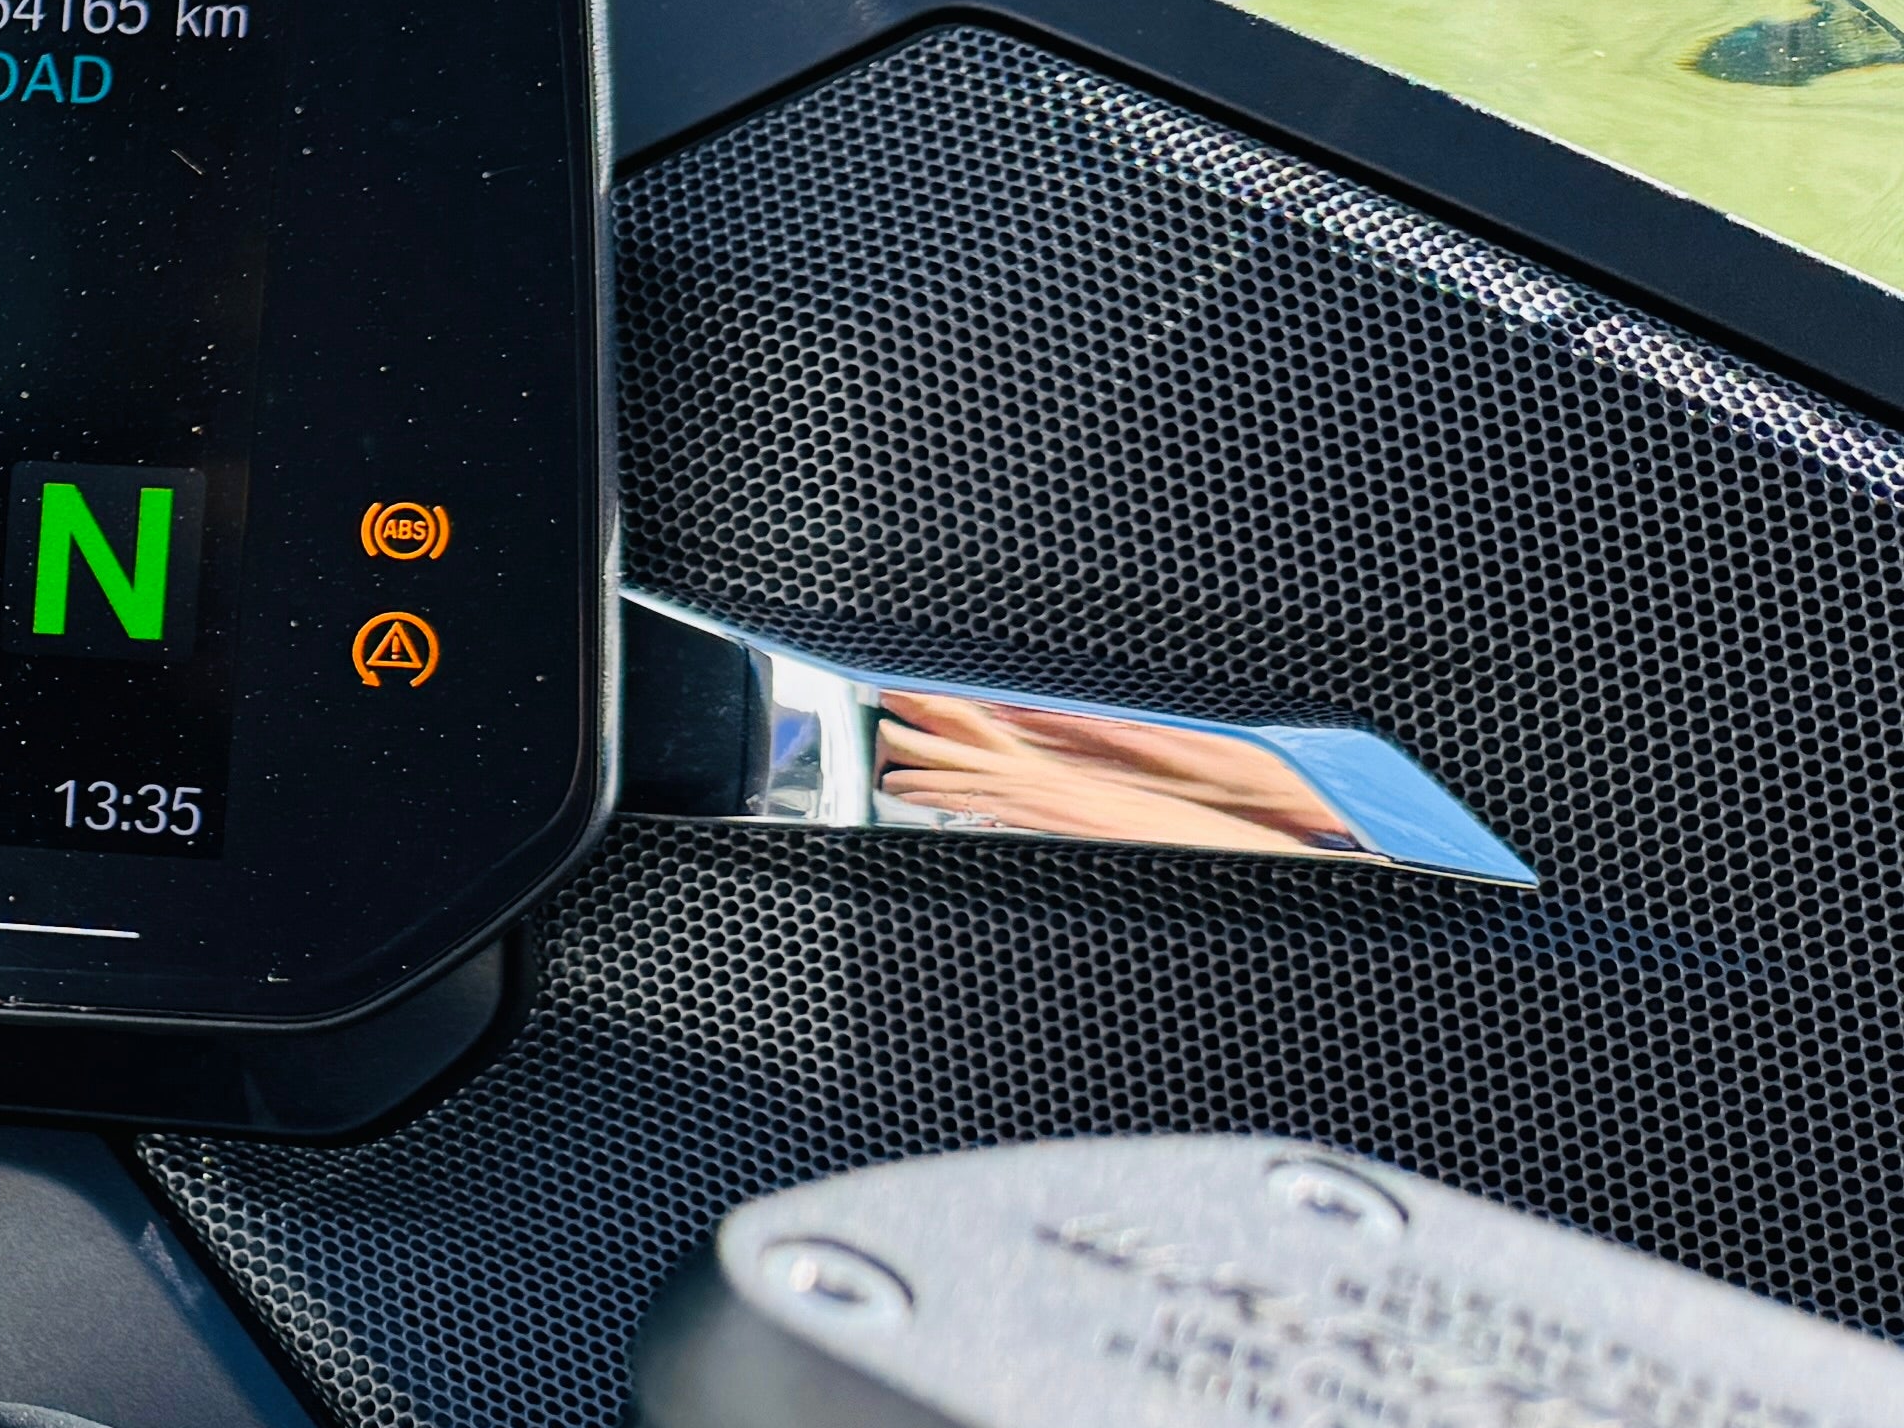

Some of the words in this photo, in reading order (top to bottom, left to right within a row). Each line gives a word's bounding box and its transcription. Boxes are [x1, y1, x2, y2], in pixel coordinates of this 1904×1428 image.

[382, 518, 427, 542] ABS
[32, 482, 174, 641] N
[54, 779, 204, 836] 13:35
